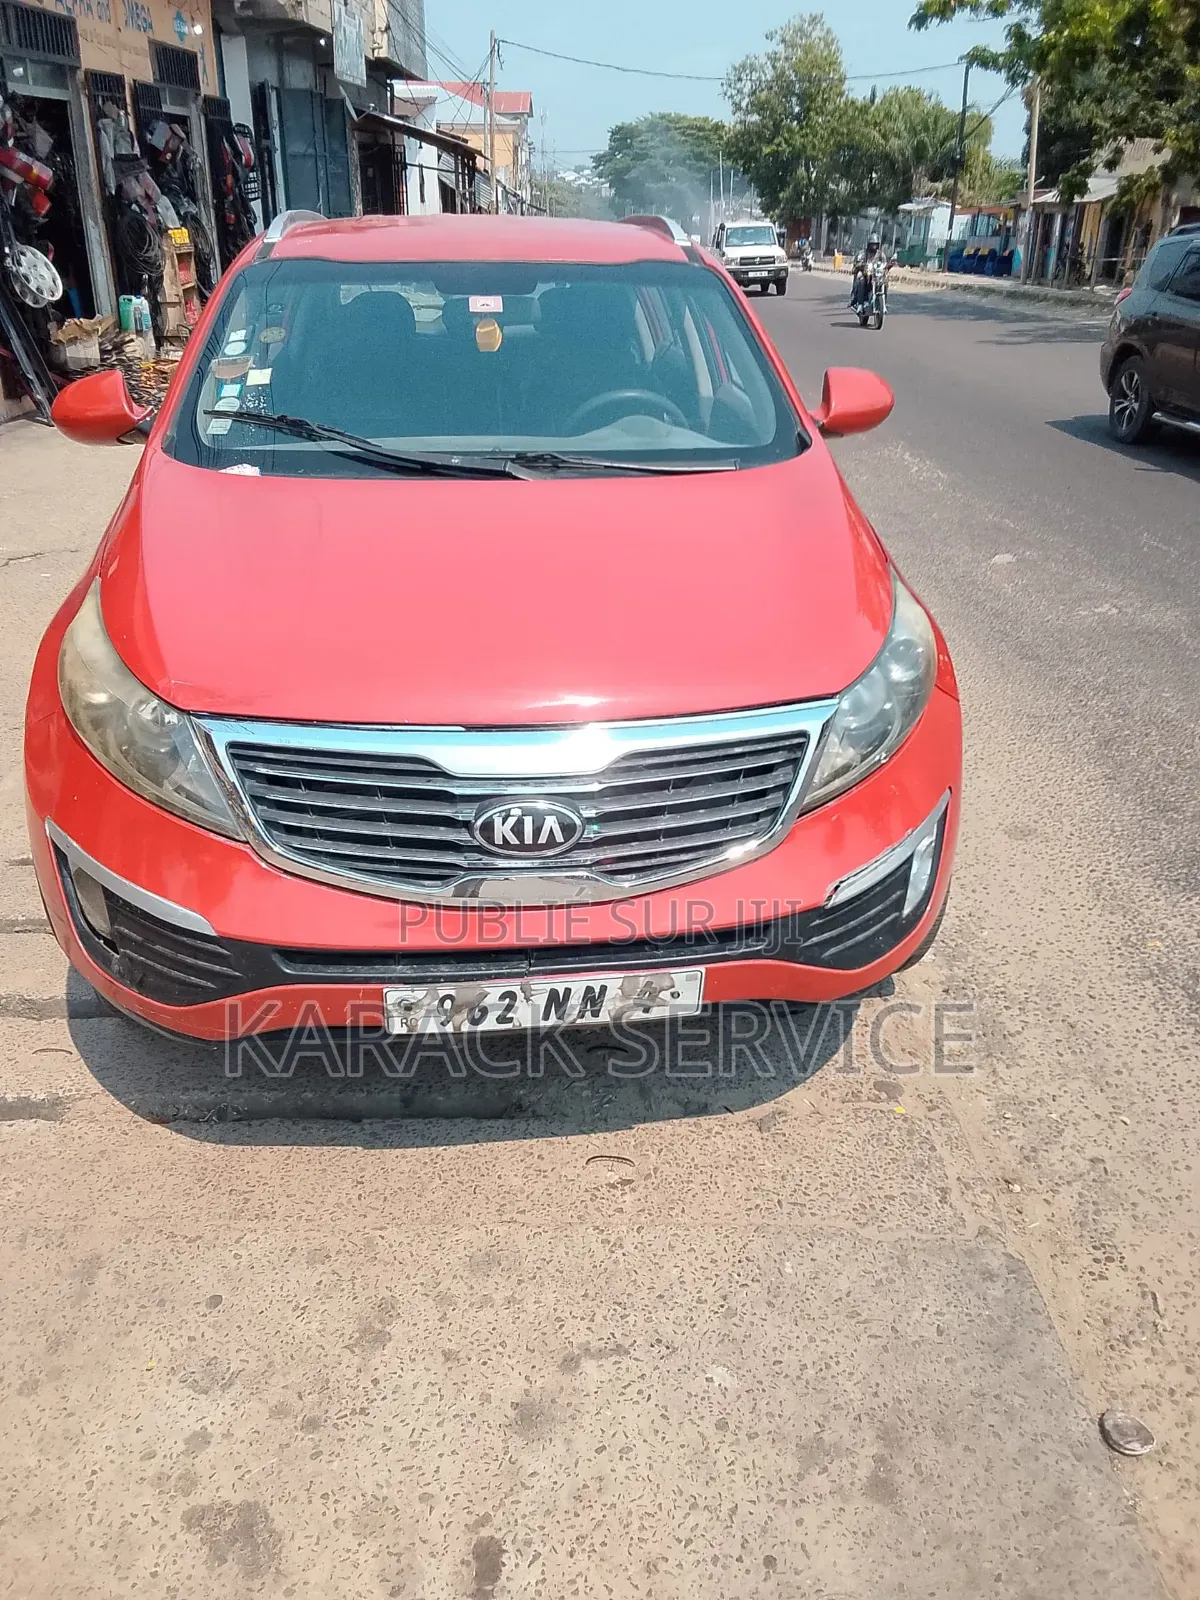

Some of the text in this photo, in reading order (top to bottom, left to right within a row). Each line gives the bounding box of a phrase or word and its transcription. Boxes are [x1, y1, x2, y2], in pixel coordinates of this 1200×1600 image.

[492, 814, 565, 845] KIA
[436, 990, 518, 1027] 962
[541, 984, 608, 1022] NN
